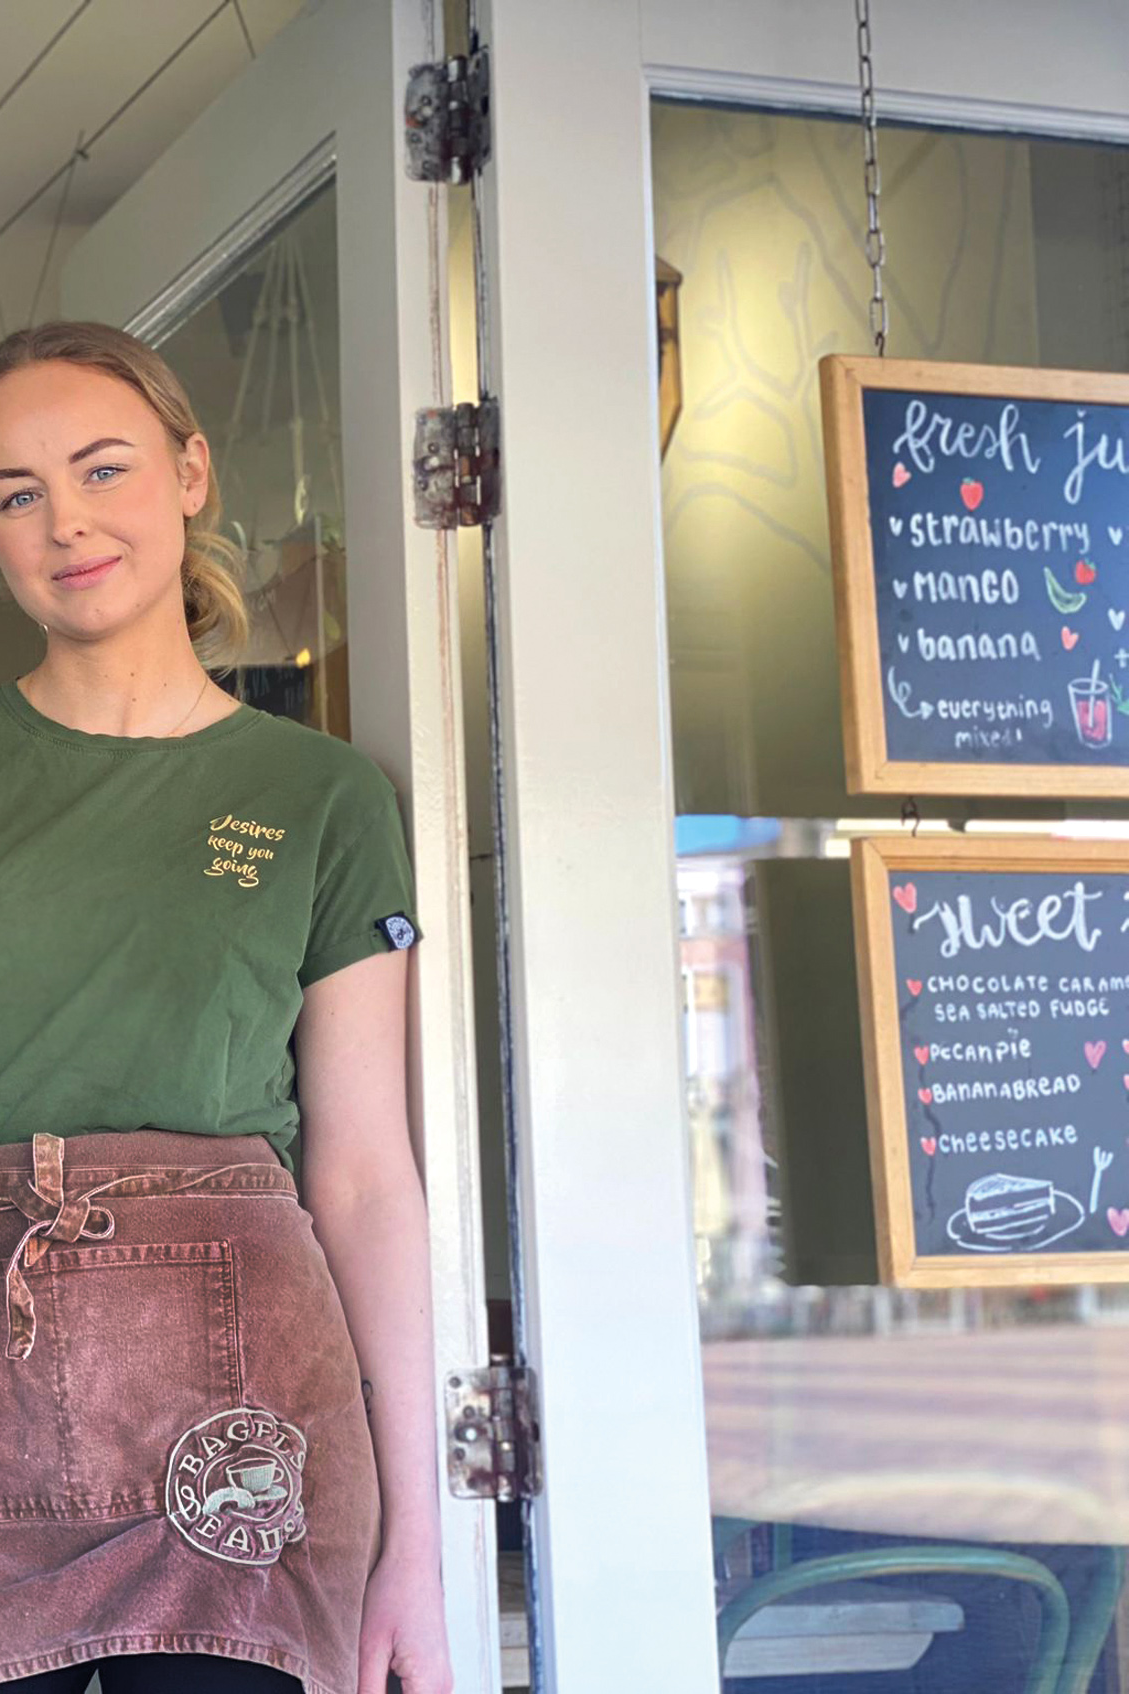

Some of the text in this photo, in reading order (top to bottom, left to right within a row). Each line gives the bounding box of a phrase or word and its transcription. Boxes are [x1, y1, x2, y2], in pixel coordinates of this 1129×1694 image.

[893, 400, 1041, 473] fresh
[910, 511, 1091, 554] strawberry
[917, 628, 1041, 662] banana
[937, 694, 1054, 729] everything
[207, 834, 275, 860] keep you
[203, 857, 259, 888] going
[1050, 997, 1110, 1018] FUDGE
